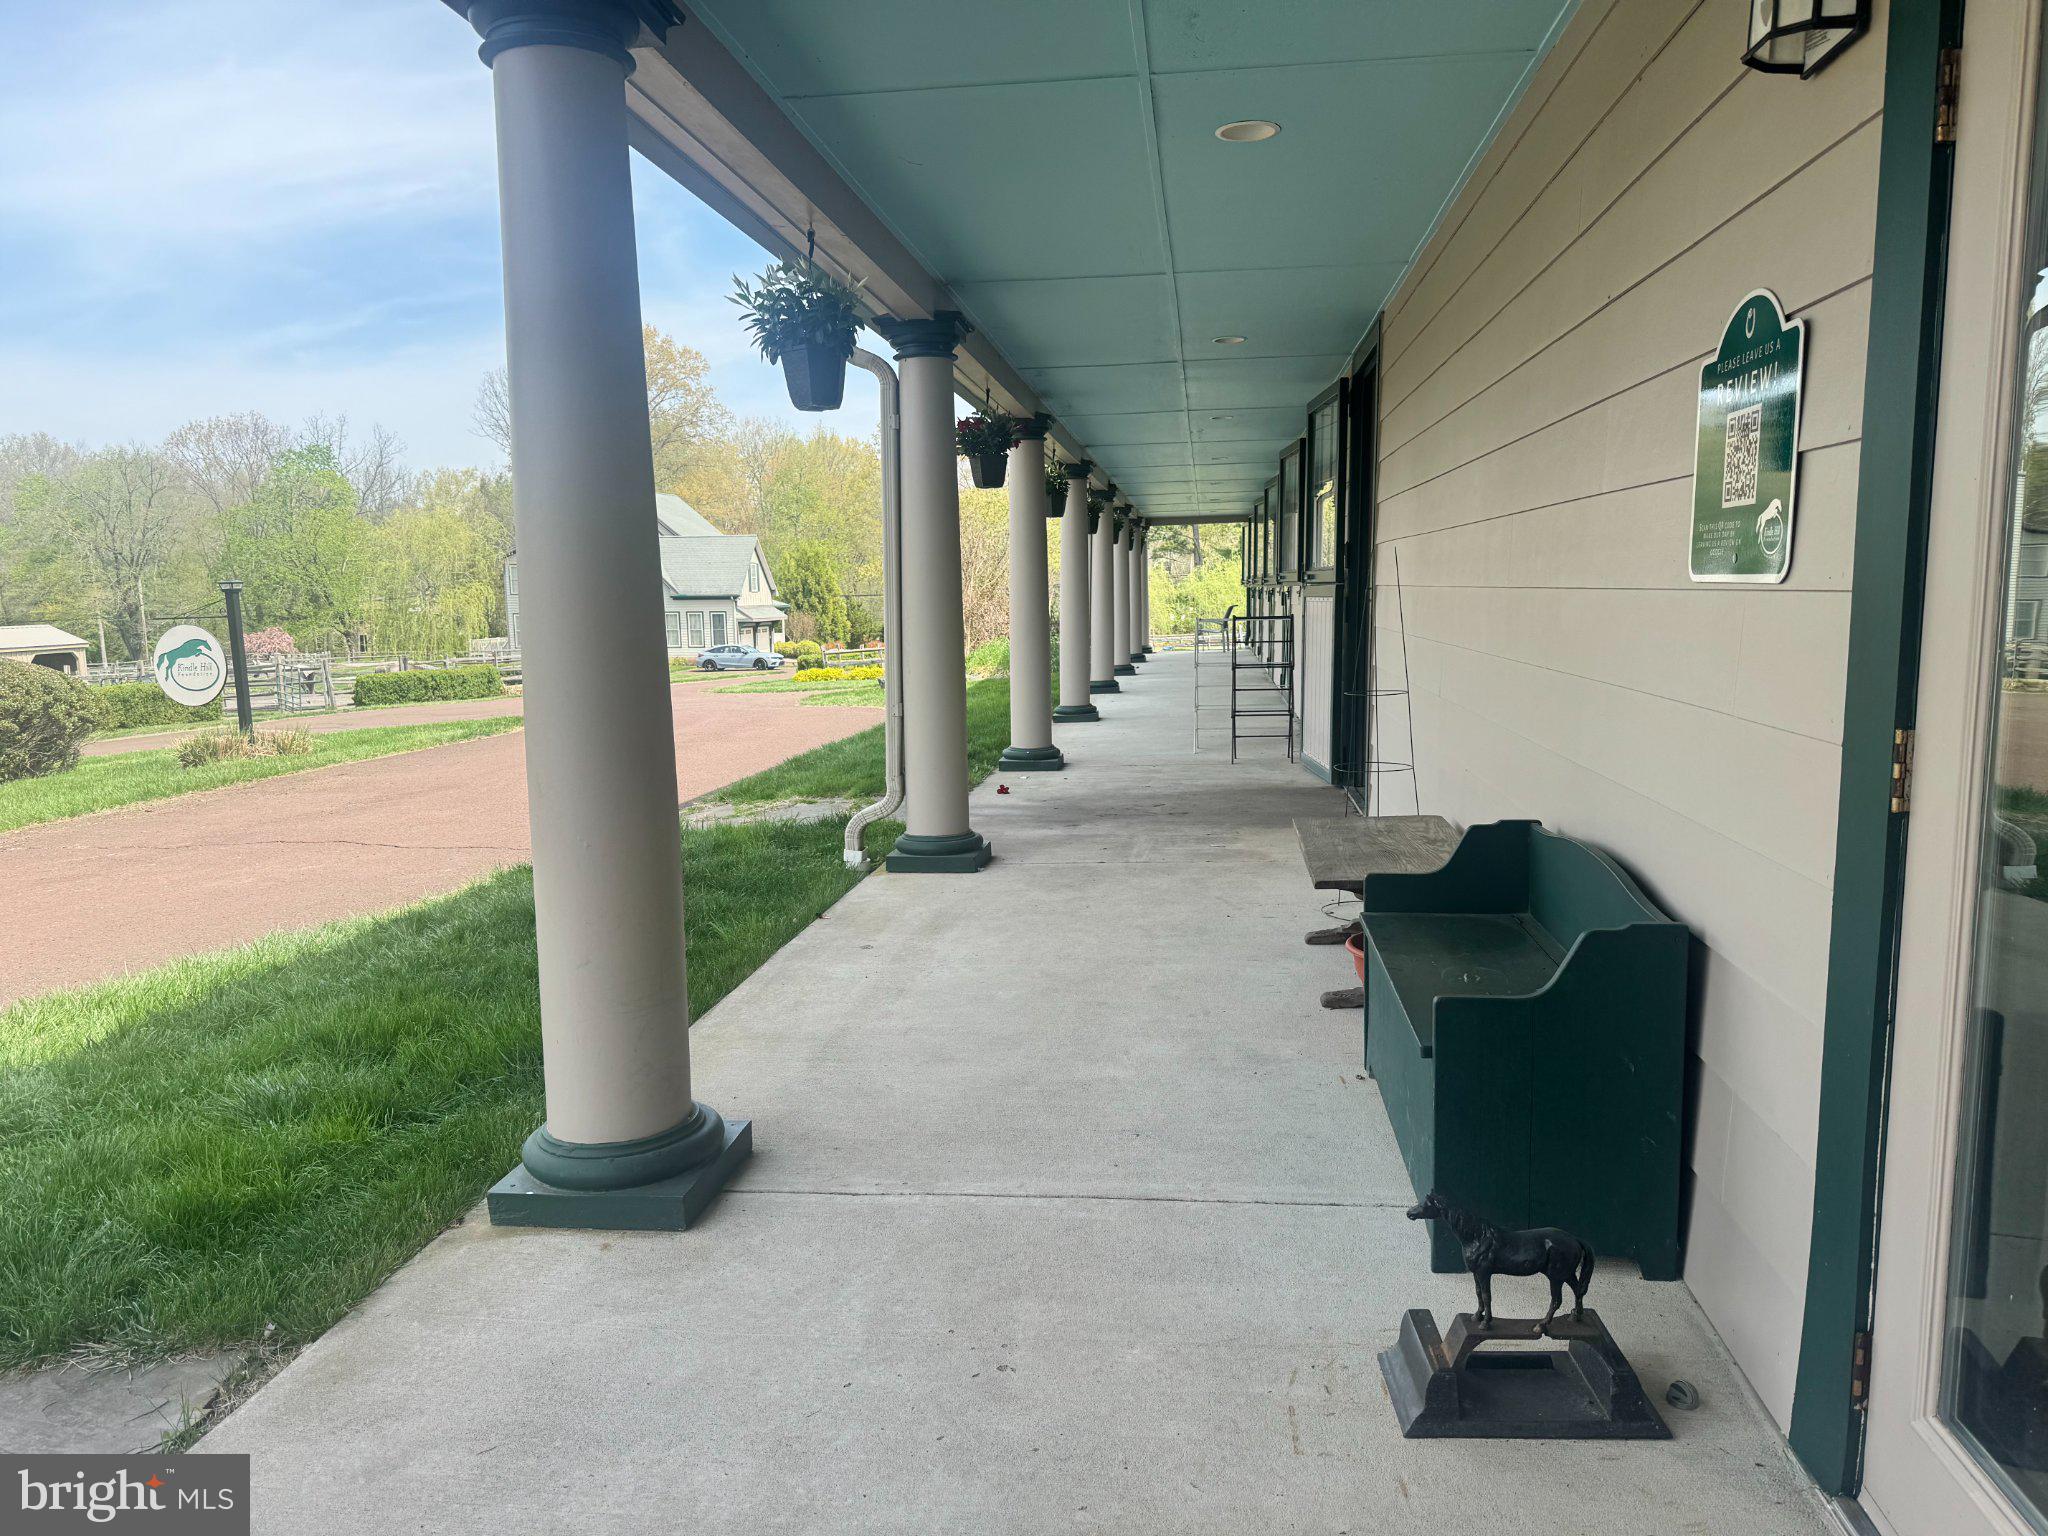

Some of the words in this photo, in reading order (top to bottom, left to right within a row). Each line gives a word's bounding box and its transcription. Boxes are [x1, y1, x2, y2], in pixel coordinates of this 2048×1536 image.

[1717, 355, 1740, 374] PLEASE
[1742, 345, 1763, 364] LEAVE
[1765, 341, 1774, 355] US
[1775, 338, 1781, 351] A
[1717, 361, 1778, 406] REVIEW!
[177, 662, 198, 672] Kindle
[200, 662, 213, 672] Hill
